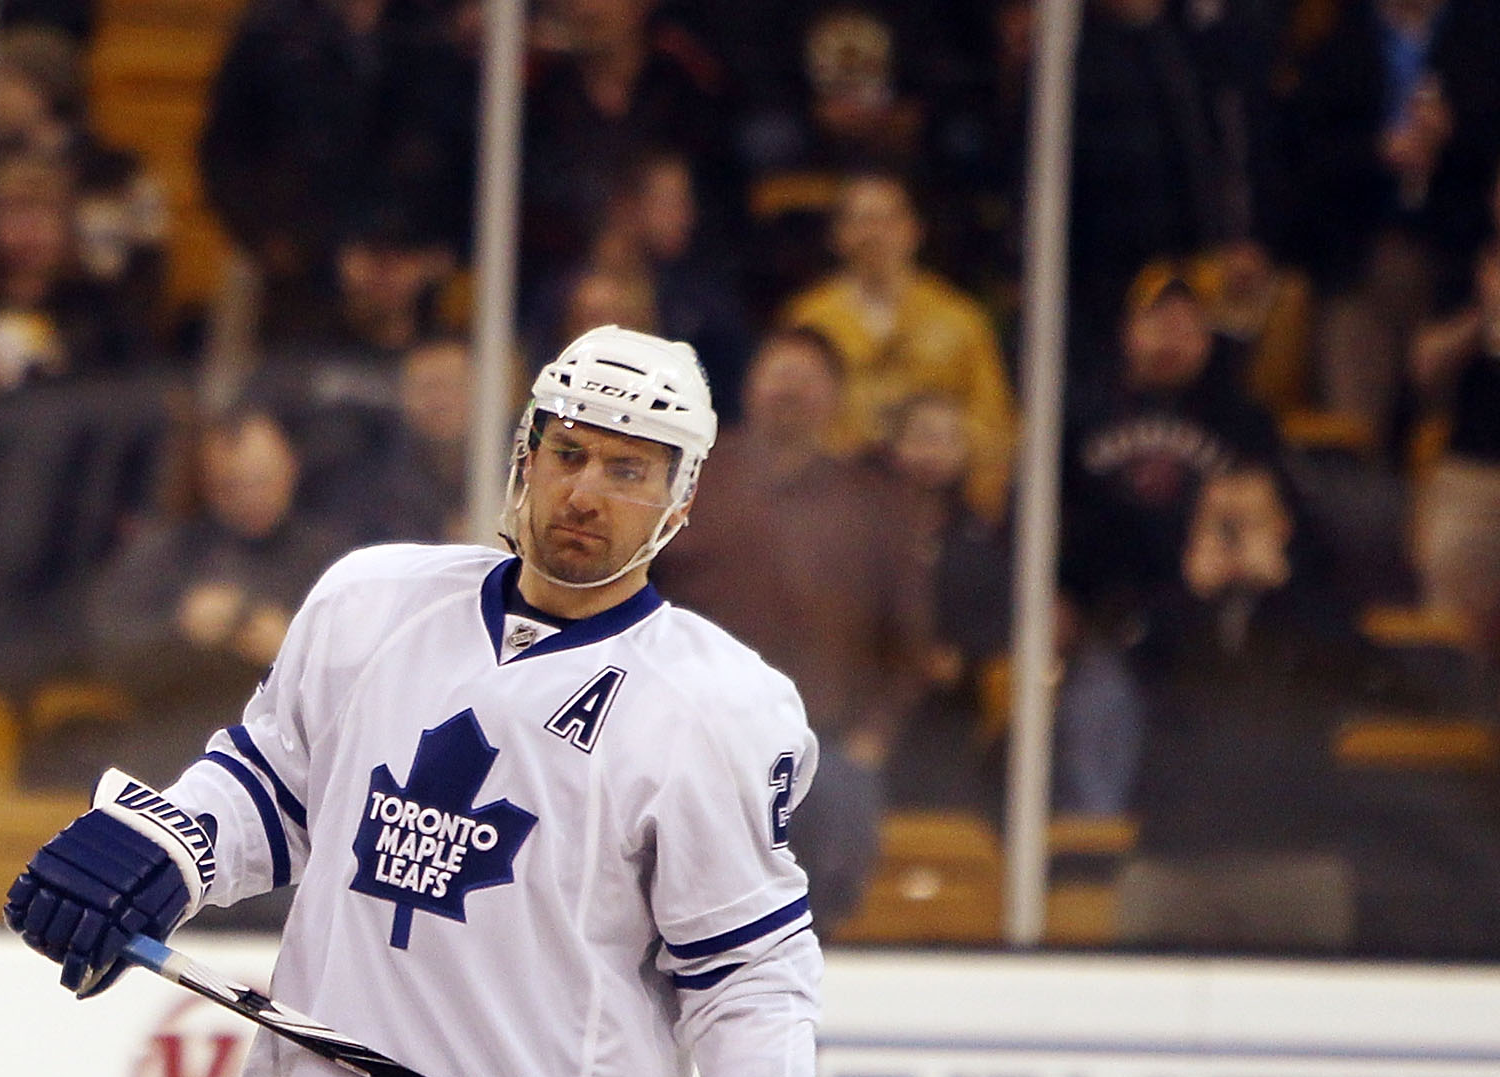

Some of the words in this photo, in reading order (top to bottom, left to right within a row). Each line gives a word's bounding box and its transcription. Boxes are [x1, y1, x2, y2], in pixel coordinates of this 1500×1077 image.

[543, 665, 628, 756] A
[369, 791, 499, 851] TORONTO
[375, 824, 467, 874] MAPLE
[375, 853, 452, 898] LEAFS
